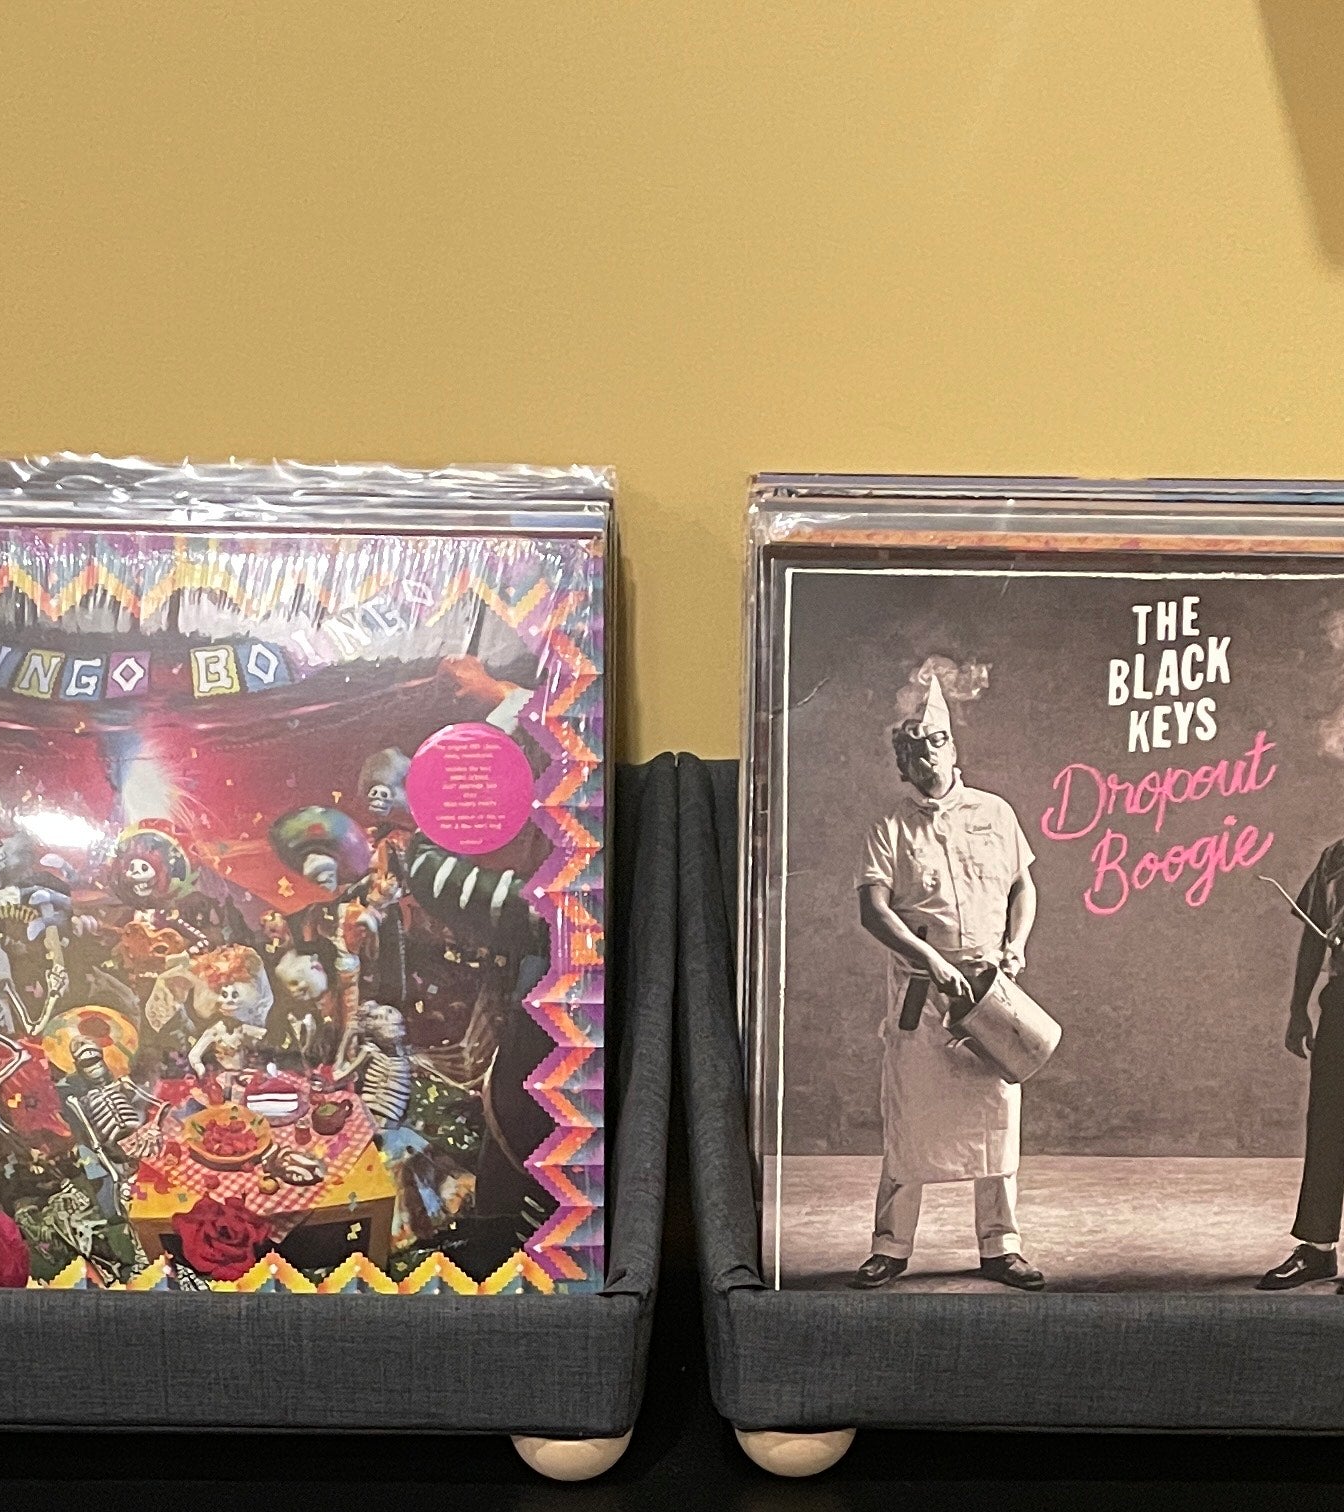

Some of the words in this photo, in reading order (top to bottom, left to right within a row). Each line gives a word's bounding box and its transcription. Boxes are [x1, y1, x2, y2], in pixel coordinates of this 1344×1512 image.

[196, 580, 435, 696] BOINGO
[1132, 595, 1201, 645] THE
[1107, 636, 1232, 706] BLACK
[1128, 697, 1218, 753] KEYS
[1040, 730, 1278, 841] Dropout
[1083, 814, 1275, 916] Boogie
